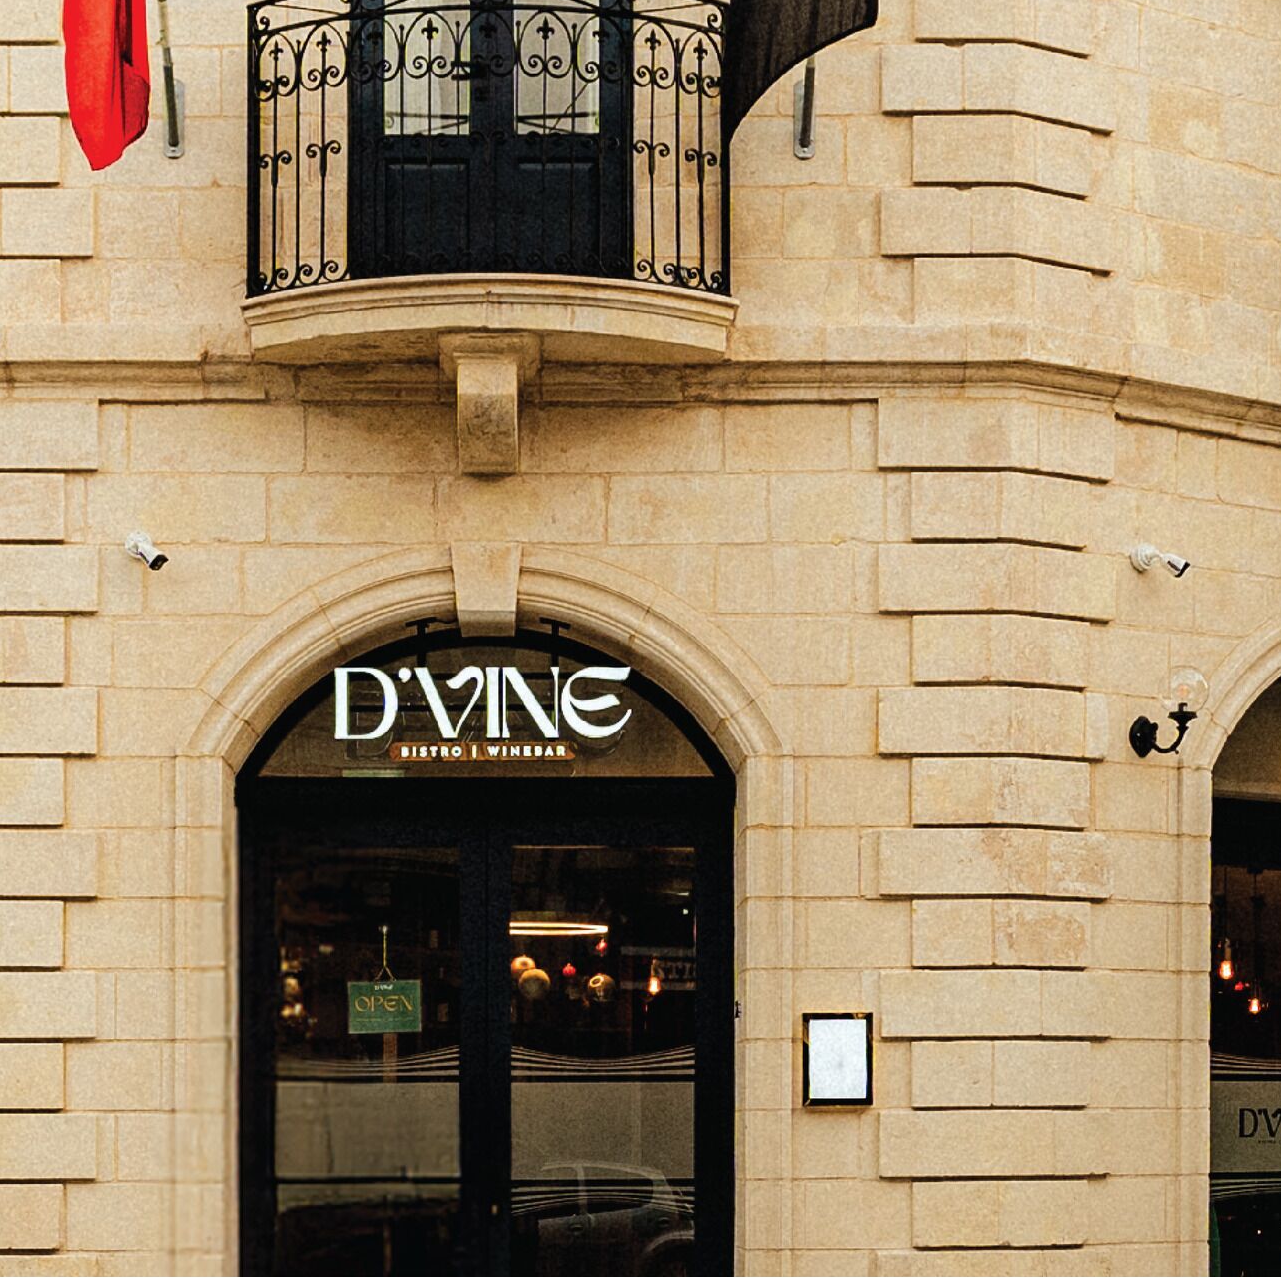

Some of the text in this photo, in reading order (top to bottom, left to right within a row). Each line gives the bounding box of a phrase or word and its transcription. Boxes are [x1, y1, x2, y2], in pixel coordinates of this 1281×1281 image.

[401, 745, 567, 758] BISTRO WINEBAR
[354, 995, 413, 1013] OPEN
